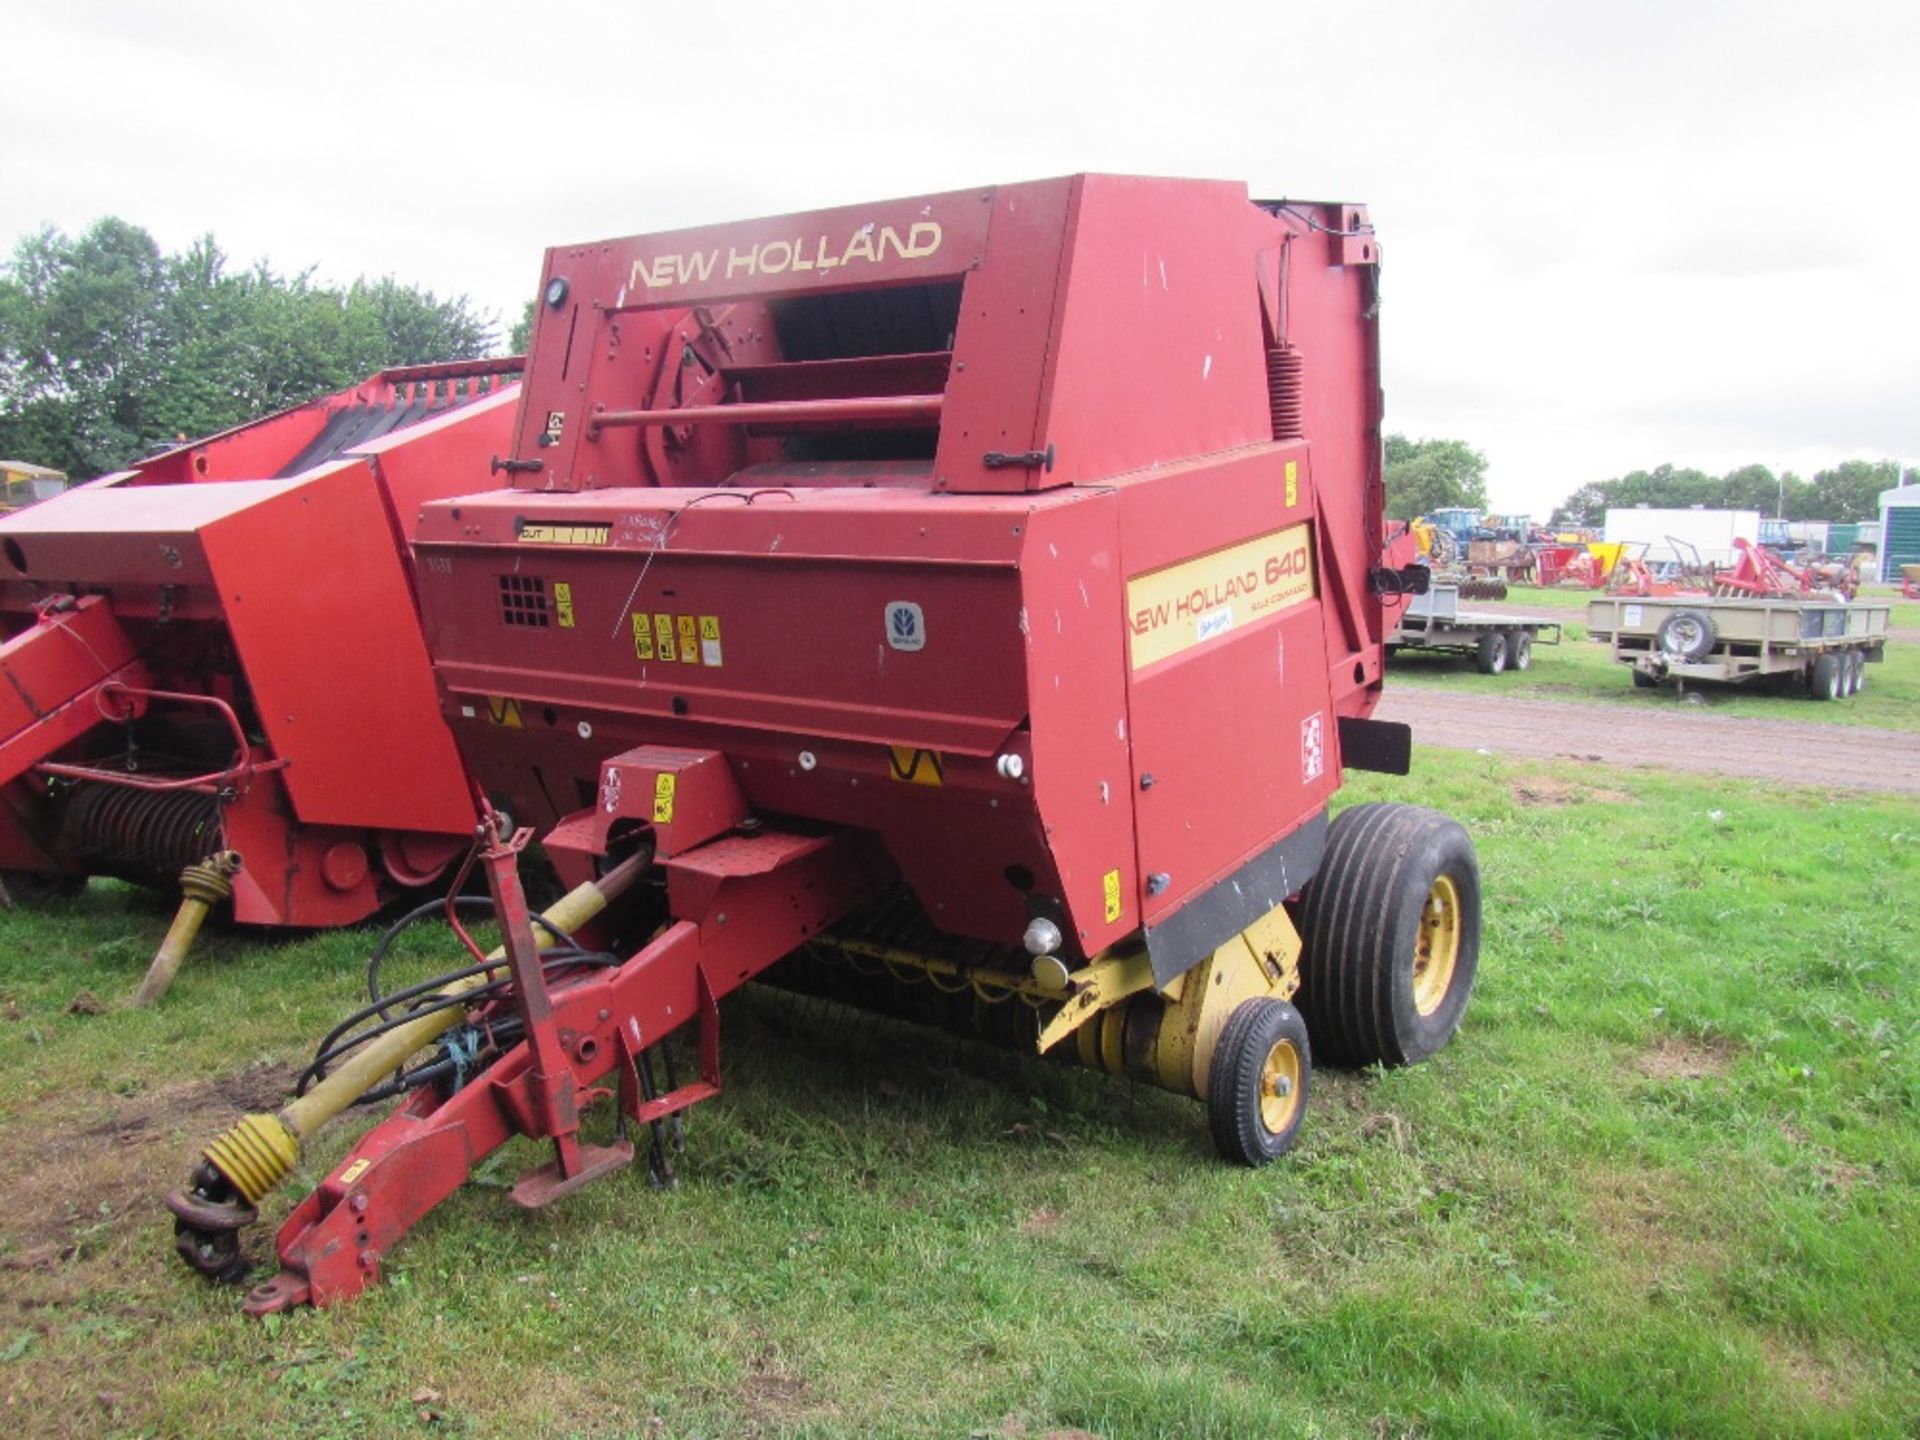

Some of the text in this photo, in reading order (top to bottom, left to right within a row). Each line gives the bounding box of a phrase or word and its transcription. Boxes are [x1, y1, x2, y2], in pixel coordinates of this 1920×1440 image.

[628, 222, 943, 290] NEW HOLLAND
[1176, 571, 1258, 620] HOLLAND
[1265, 547, 1306, 586] 640
